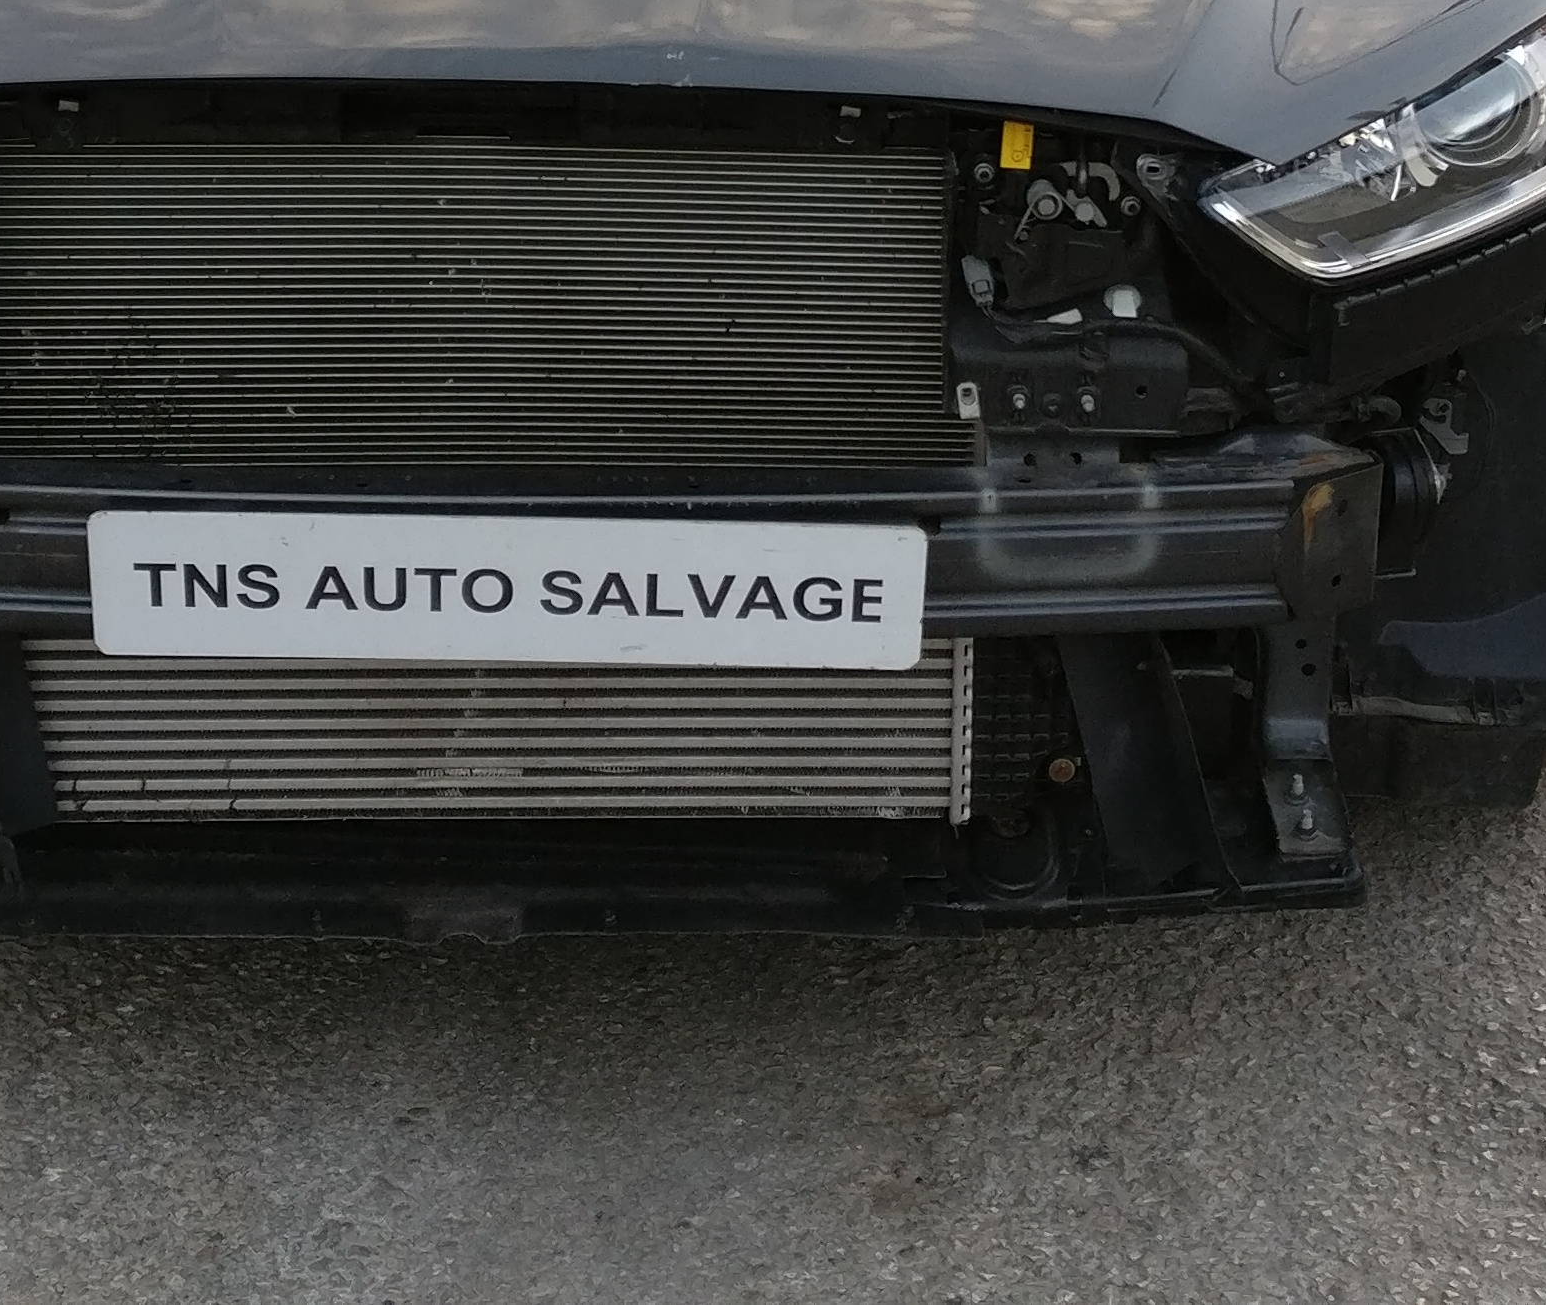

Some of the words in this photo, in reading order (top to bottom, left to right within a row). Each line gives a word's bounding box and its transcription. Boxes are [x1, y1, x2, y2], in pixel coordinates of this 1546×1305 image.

[133, 563, 282, 609] TNS
[305, 566, 515, 614] AUTO
[540, 570, 883, 623] SALVAGE
